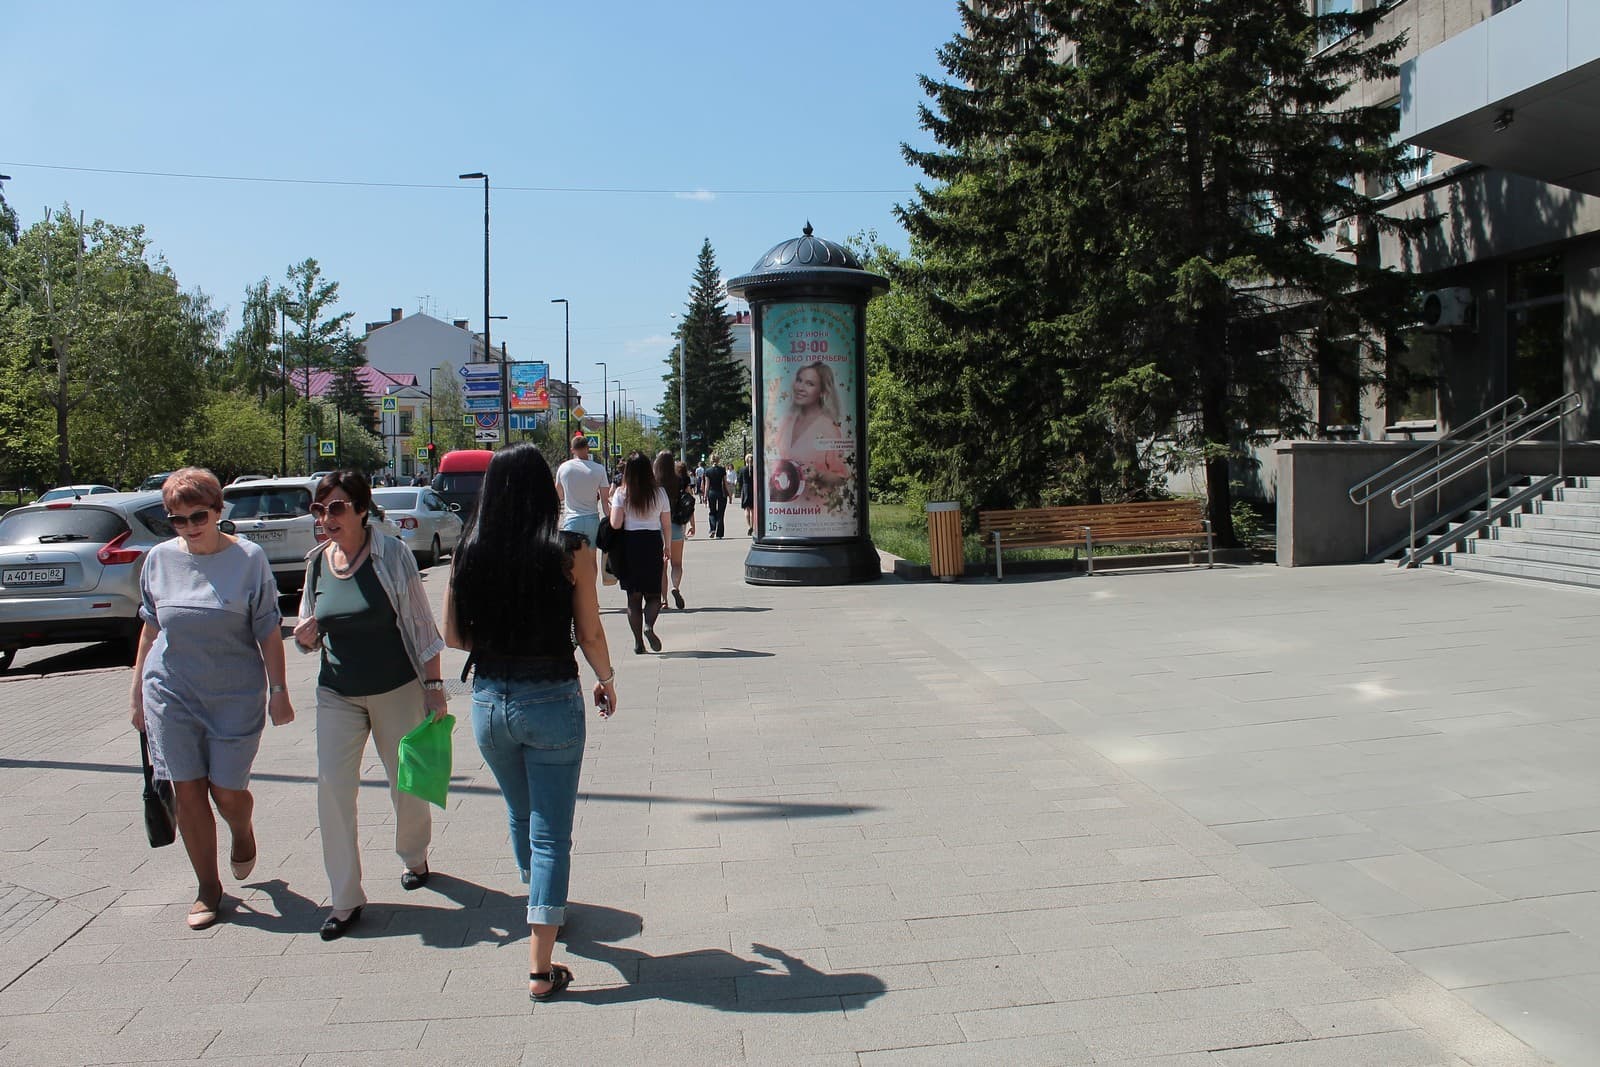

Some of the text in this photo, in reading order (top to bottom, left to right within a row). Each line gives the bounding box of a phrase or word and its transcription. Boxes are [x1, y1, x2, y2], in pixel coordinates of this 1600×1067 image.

[790, 340, 829, 353] 19:00
[773, 354, 849, 363] ОЛЬКО ПРЕМЬЕРЫ
[768, 522, 783, 532] 16+
